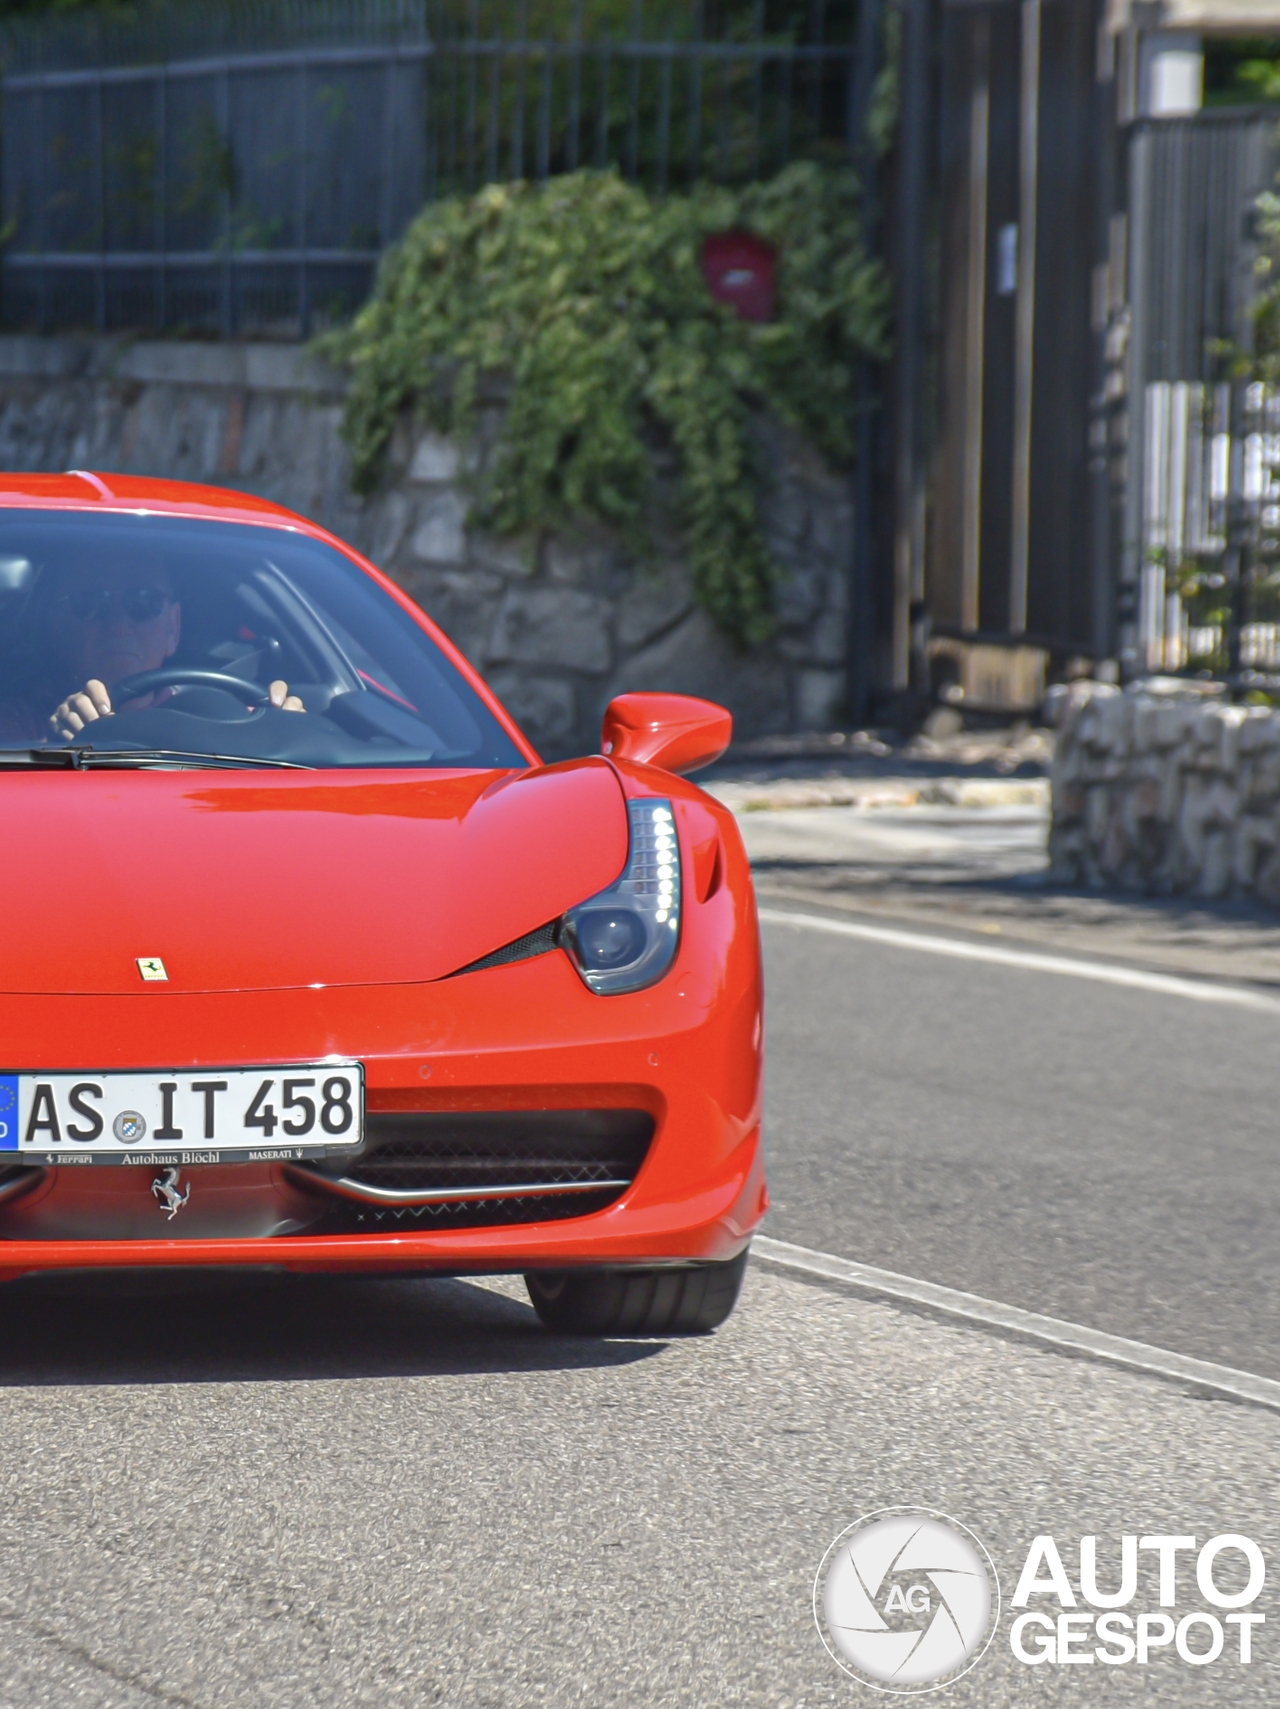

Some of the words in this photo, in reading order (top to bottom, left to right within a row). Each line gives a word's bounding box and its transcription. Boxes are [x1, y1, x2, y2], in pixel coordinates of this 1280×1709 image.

[25, 1082, 104, 1142] AS
[153, 1080, 228, 1139] IT
[244, 1076, 352, 1137] 458
[121, 1153, 178, 1165] Autohaus
[181, 1152, 220, 1164] Blöchl
[248, 1150, 292, 1160] MASERATI
